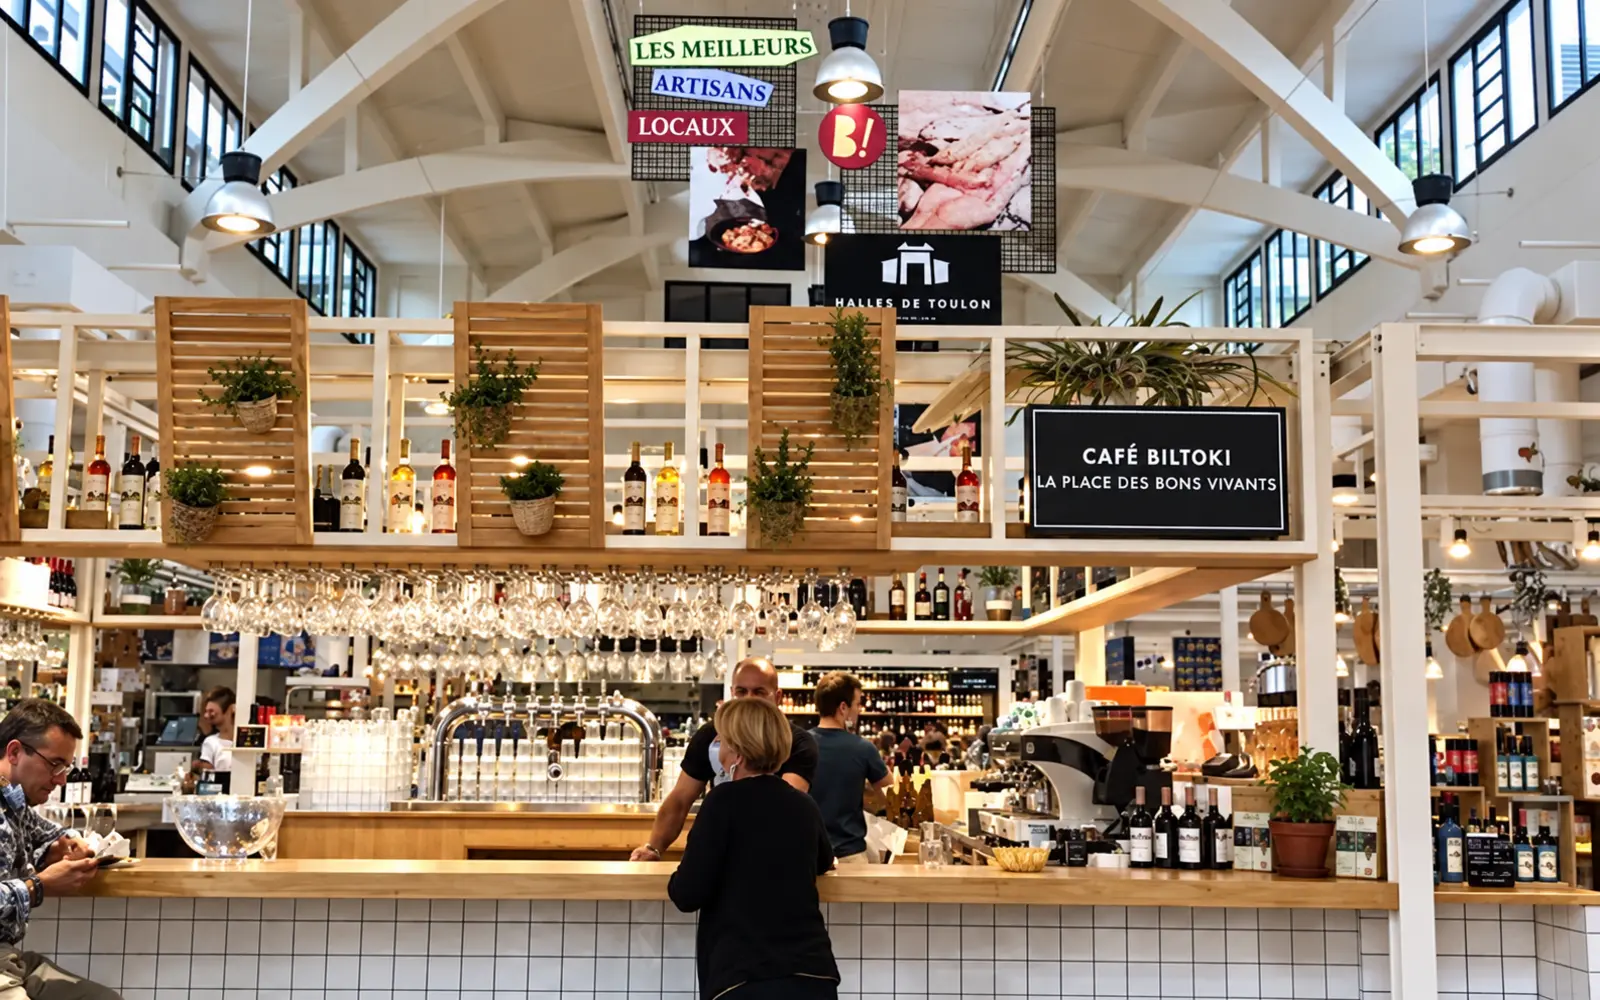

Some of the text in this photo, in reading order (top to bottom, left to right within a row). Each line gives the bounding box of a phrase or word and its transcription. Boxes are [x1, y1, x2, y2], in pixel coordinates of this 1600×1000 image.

[635, 37, 813, 60] LES MEILLEURS
[654, 74, 767, 102] ARTISANS
[638, 116, 735, 136] LOCAUX
[832, 114, 875, 158] B!
[835, 297, 991, 310] HALLES DE TOULON
[1082, 443, 1231, 466] CAFÉ BILTOKI
[1037, 475, 1277, 491] LA PLACE DES BONS VIVANTS
